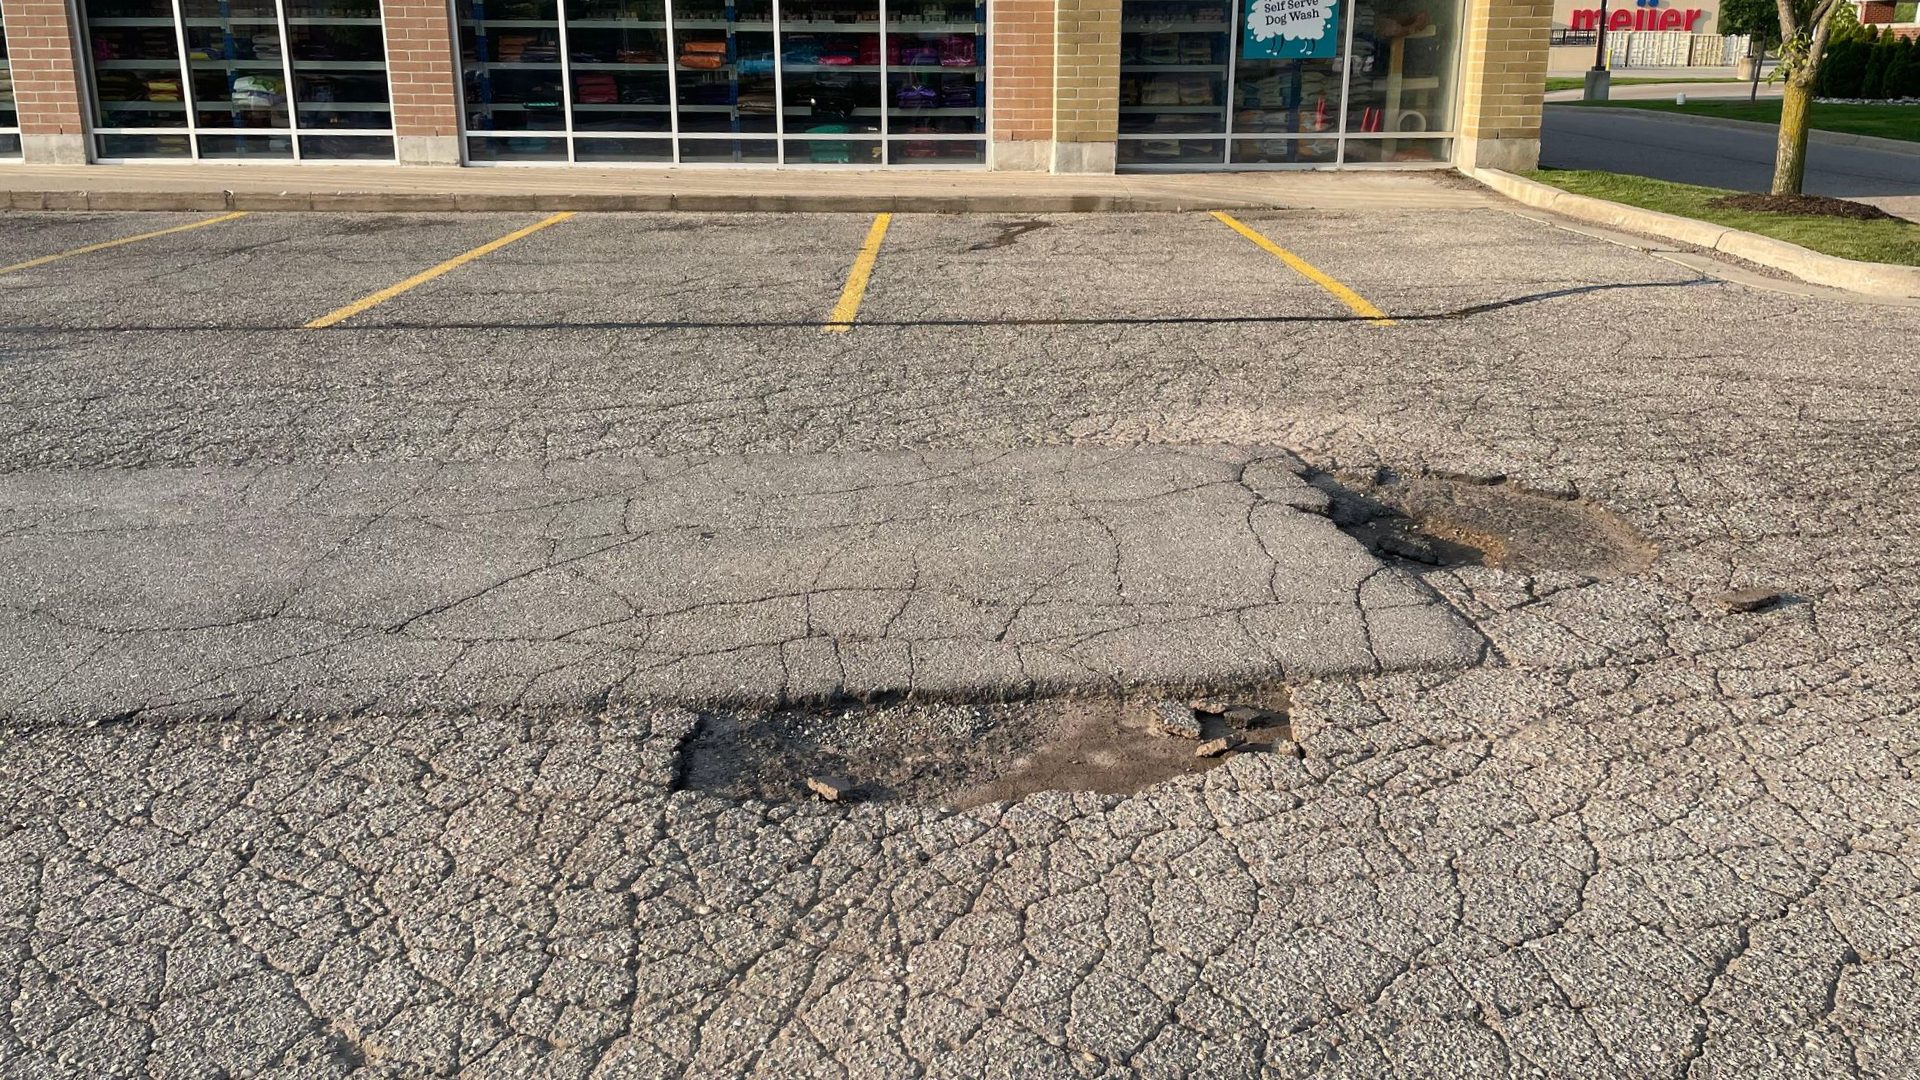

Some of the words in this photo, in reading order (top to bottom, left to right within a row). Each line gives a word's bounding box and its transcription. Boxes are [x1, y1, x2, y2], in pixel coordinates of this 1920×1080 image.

[1264, 1, 1286, 13] Self
[1287, 0, 1319, 9] Serve
[1571, 0, 1702, 31] meijer
[1265, 13, 1287, 26] Dog
[1289, 8, 1319, 21] Wash
